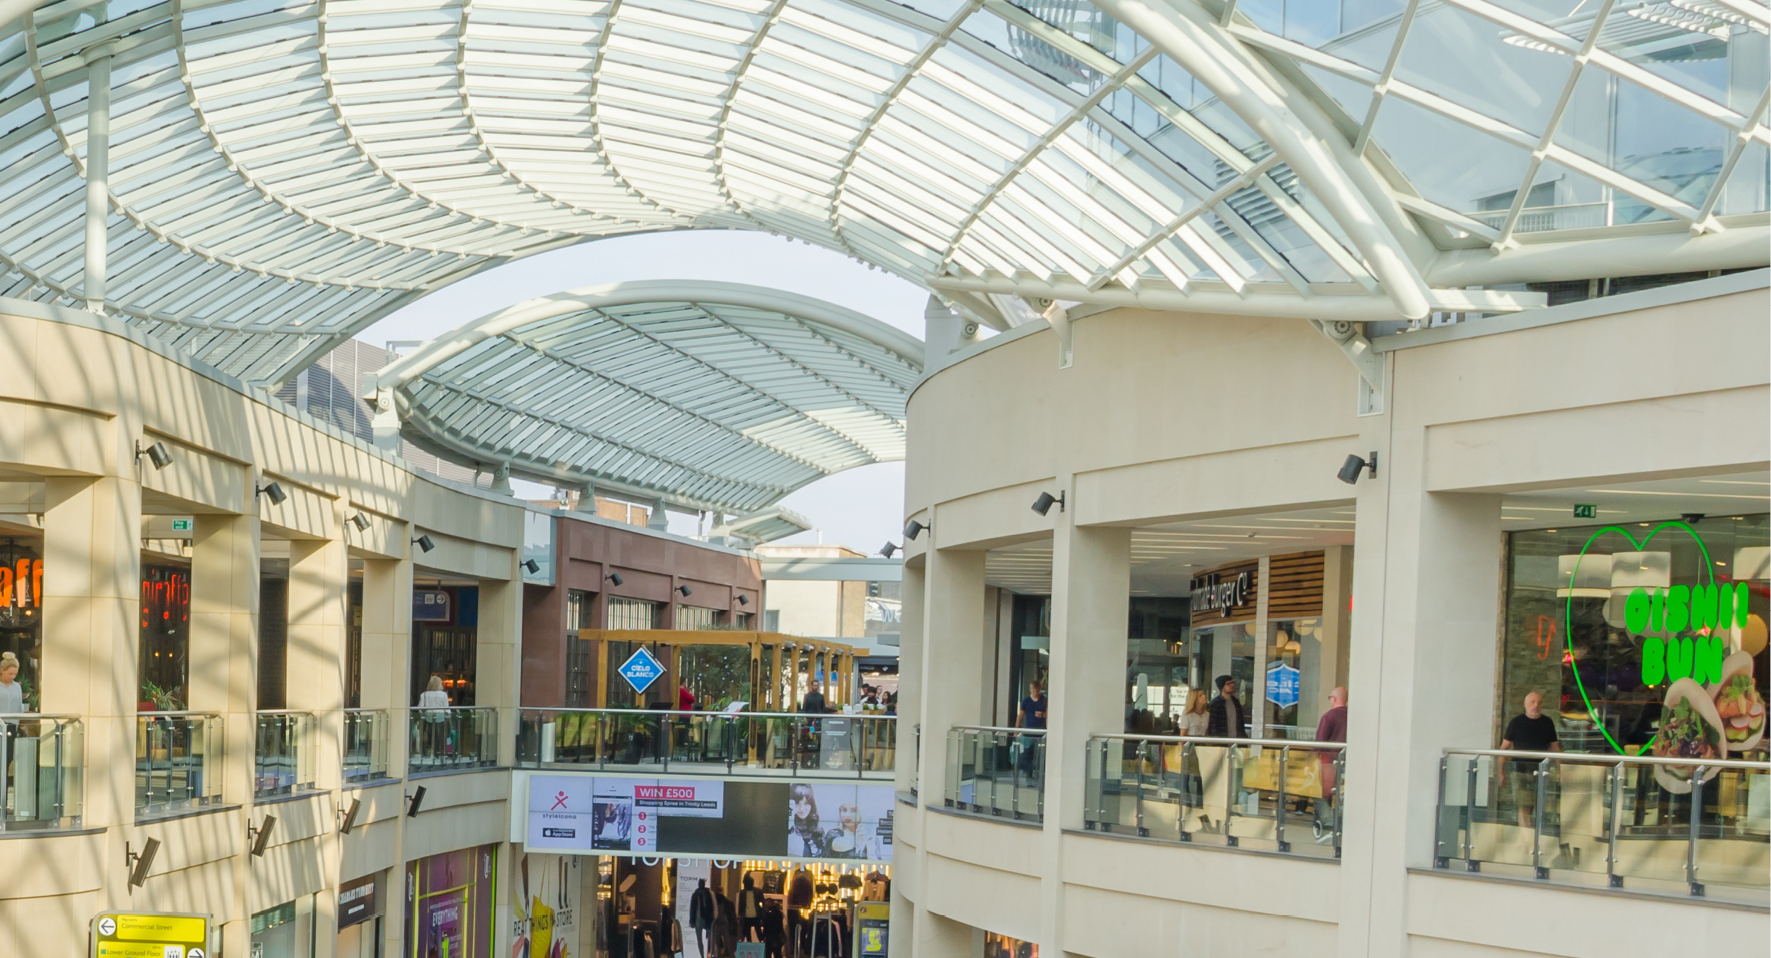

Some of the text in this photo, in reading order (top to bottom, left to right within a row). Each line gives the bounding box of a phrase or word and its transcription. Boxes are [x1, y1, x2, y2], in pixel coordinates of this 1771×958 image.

[1624, 582, 1749, 634] OISHII
[1641, 635, 1724, 686] BUN
[639, 788, 693, 798] WIN £500
[121, 923, 155, 931] Commercial
[556, 909, 573, 928] STORE
